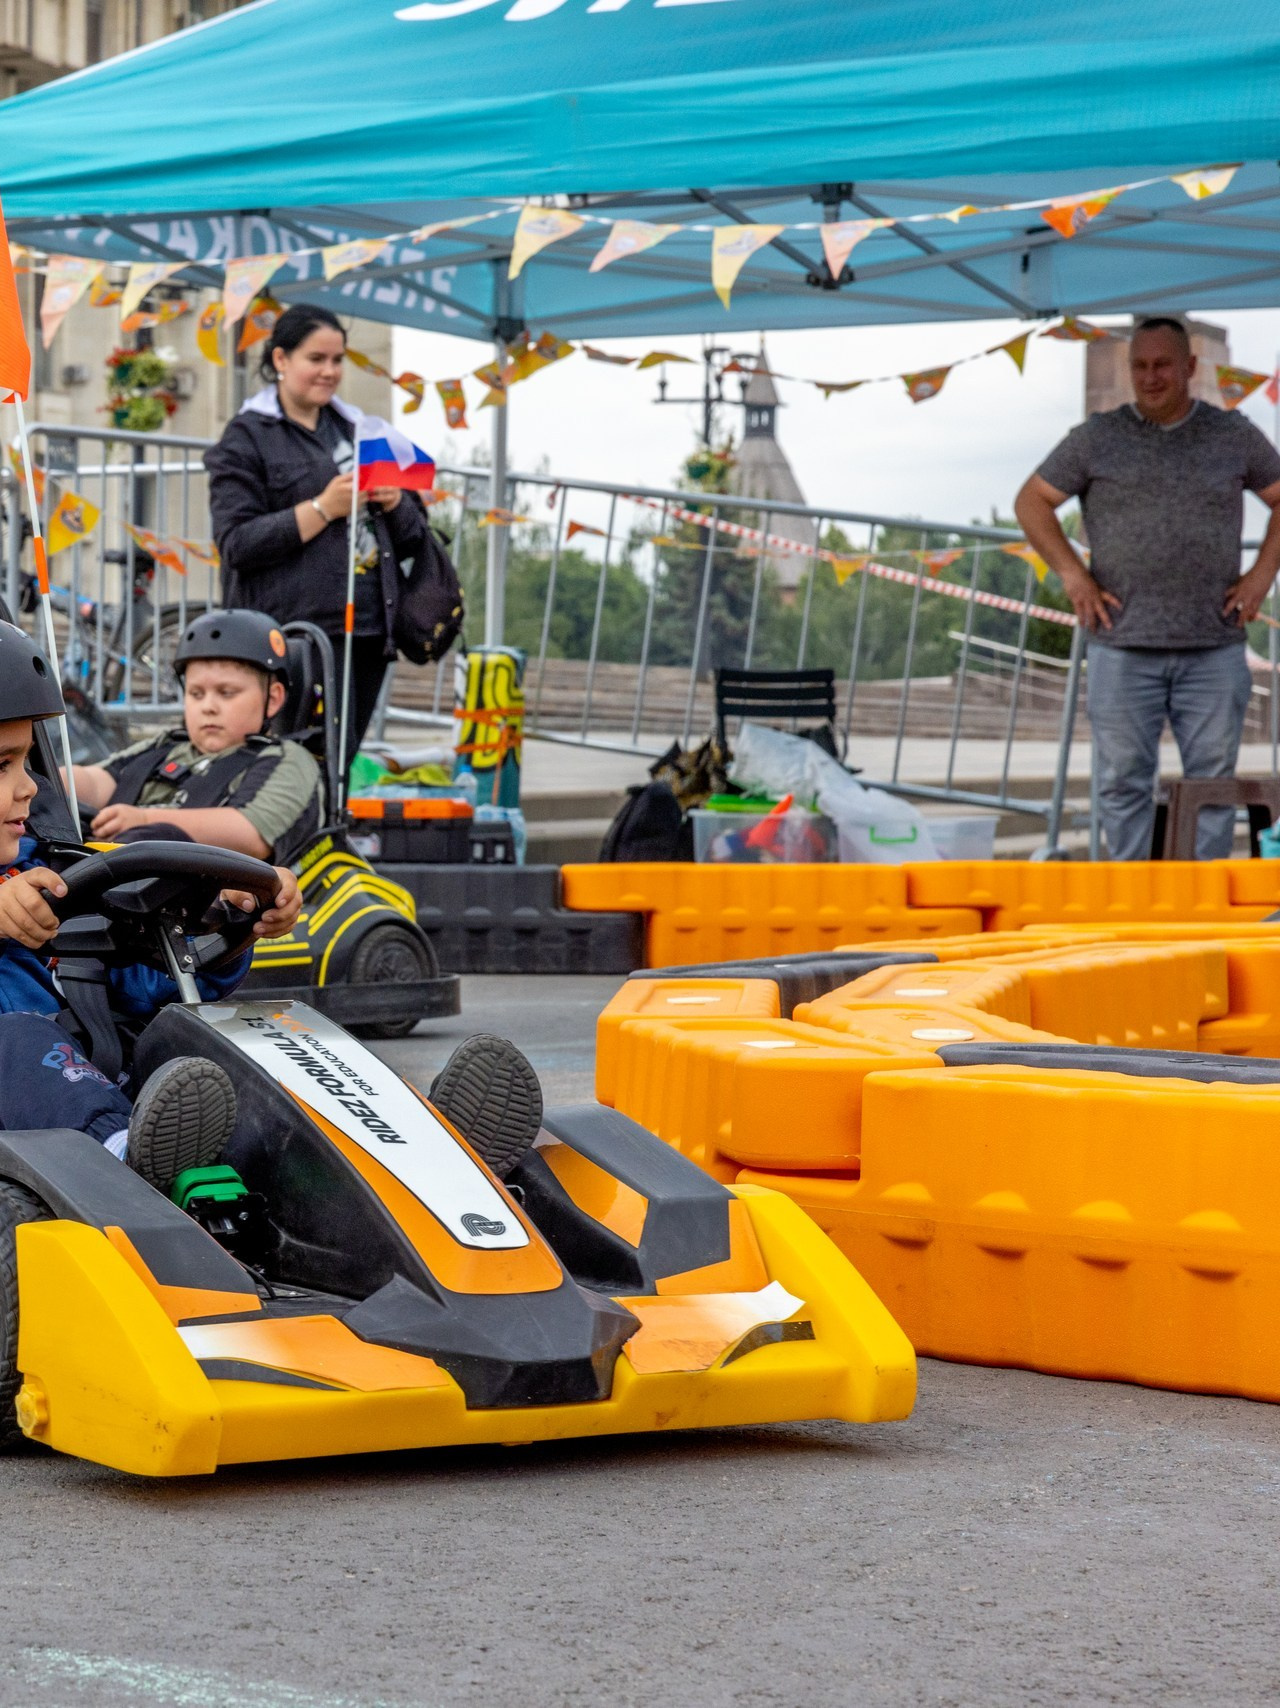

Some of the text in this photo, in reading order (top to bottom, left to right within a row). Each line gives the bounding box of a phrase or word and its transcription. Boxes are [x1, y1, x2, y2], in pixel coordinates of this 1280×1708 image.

[240, 1016, 408, 1145] RIDEZ FORMULA S1
[298, 1033, 380, 1096] FOR EDUCATION
